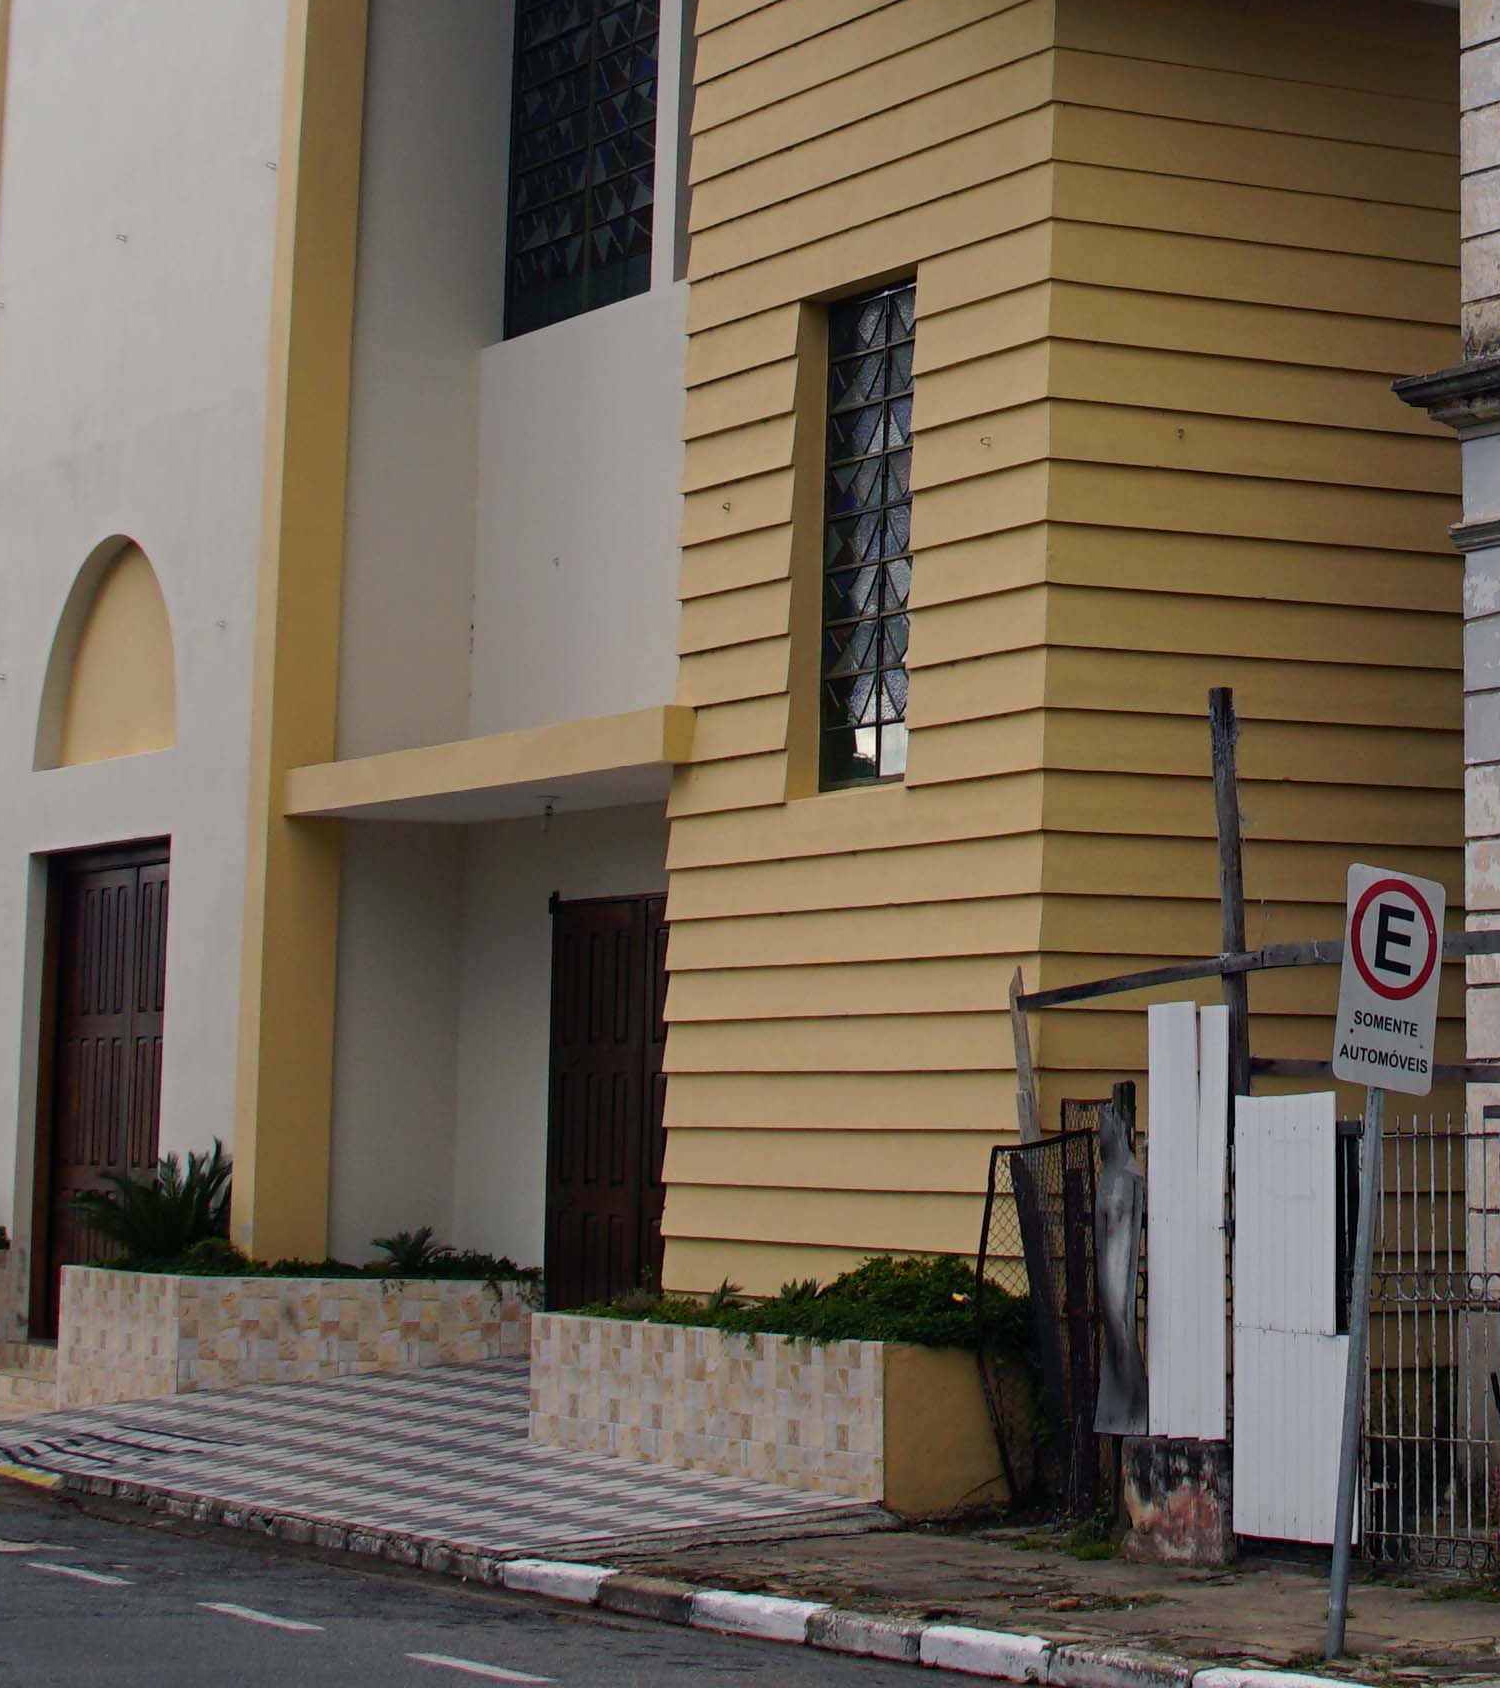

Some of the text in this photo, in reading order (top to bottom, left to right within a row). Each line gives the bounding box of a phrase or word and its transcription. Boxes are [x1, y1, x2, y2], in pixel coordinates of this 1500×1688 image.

[1374, 903, 1415, 977] E
[1353, 1010, 1419, 1038] SOMENTE
[1339, 1043, 1428, 1074] AUTOMÓVEIS
